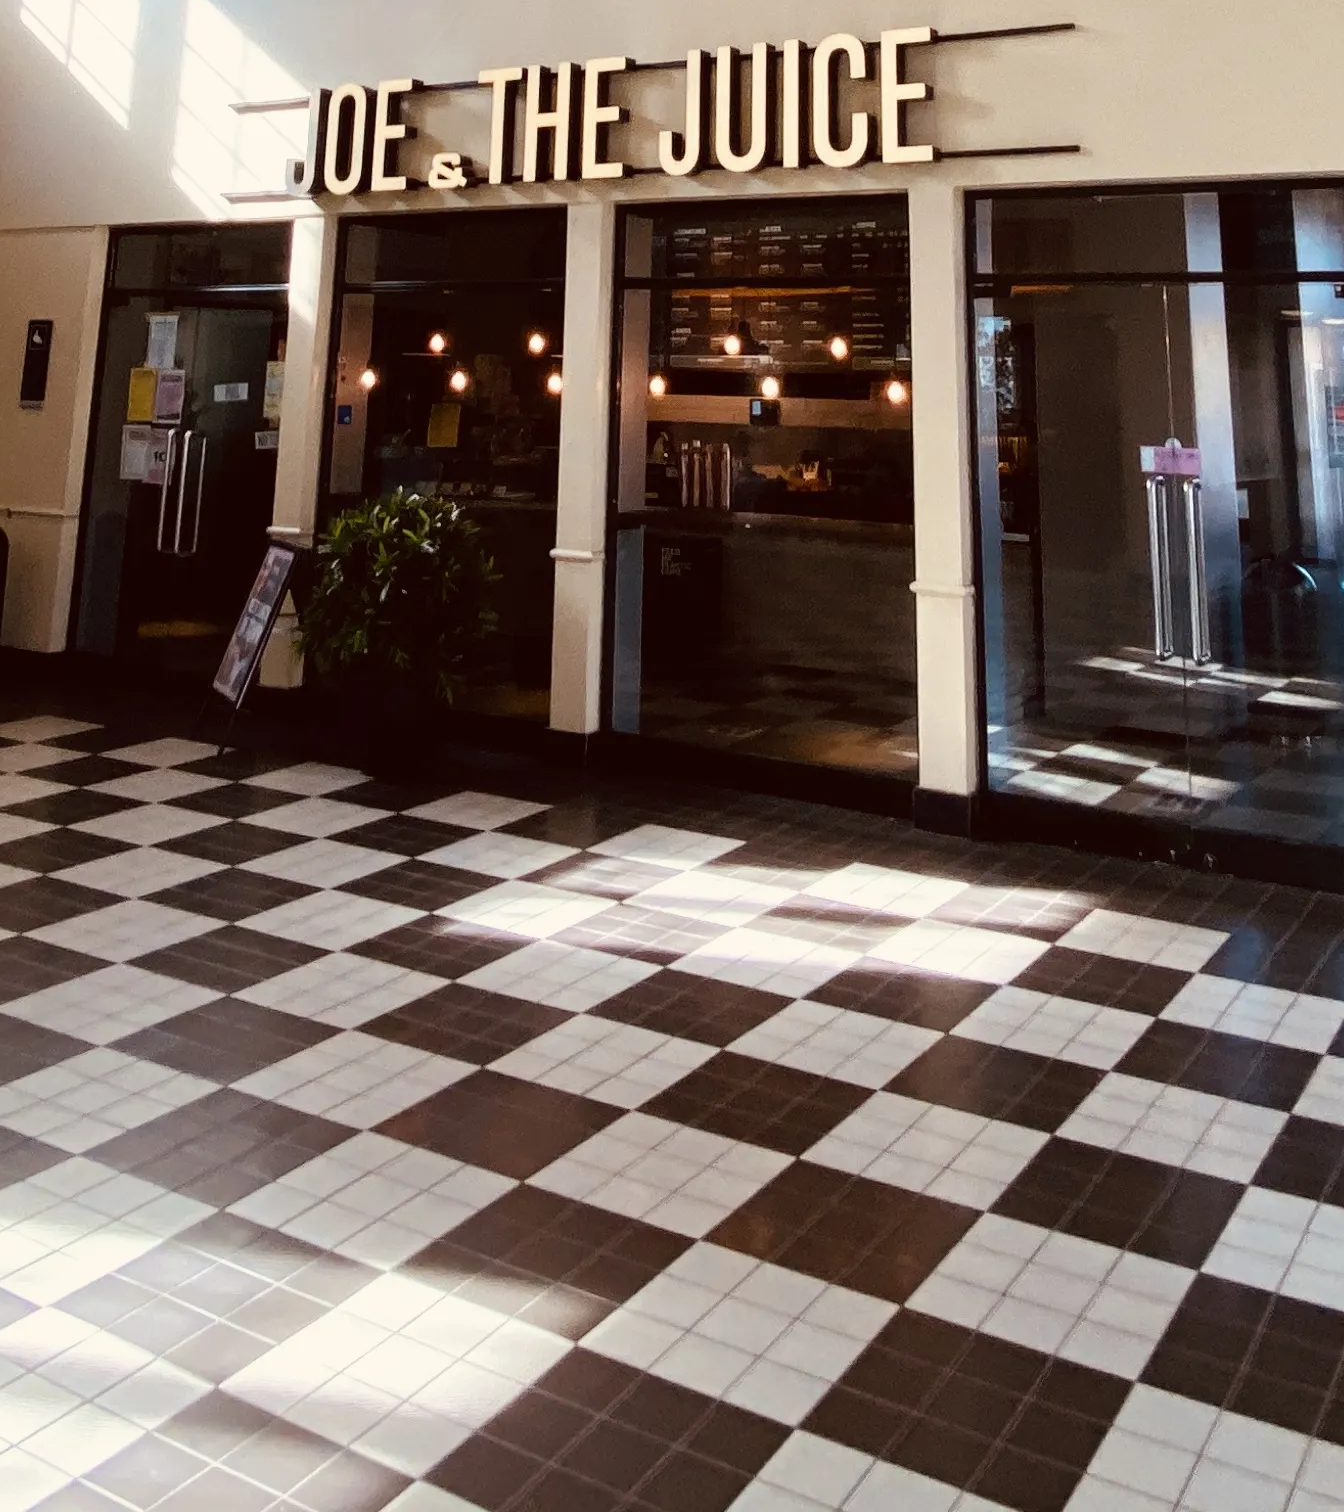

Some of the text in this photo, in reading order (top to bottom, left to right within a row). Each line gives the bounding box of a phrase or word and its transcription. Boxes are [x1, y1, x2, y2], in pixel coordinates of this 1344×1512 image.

[285, 26, 938, 198] JOE & THE JUICE
